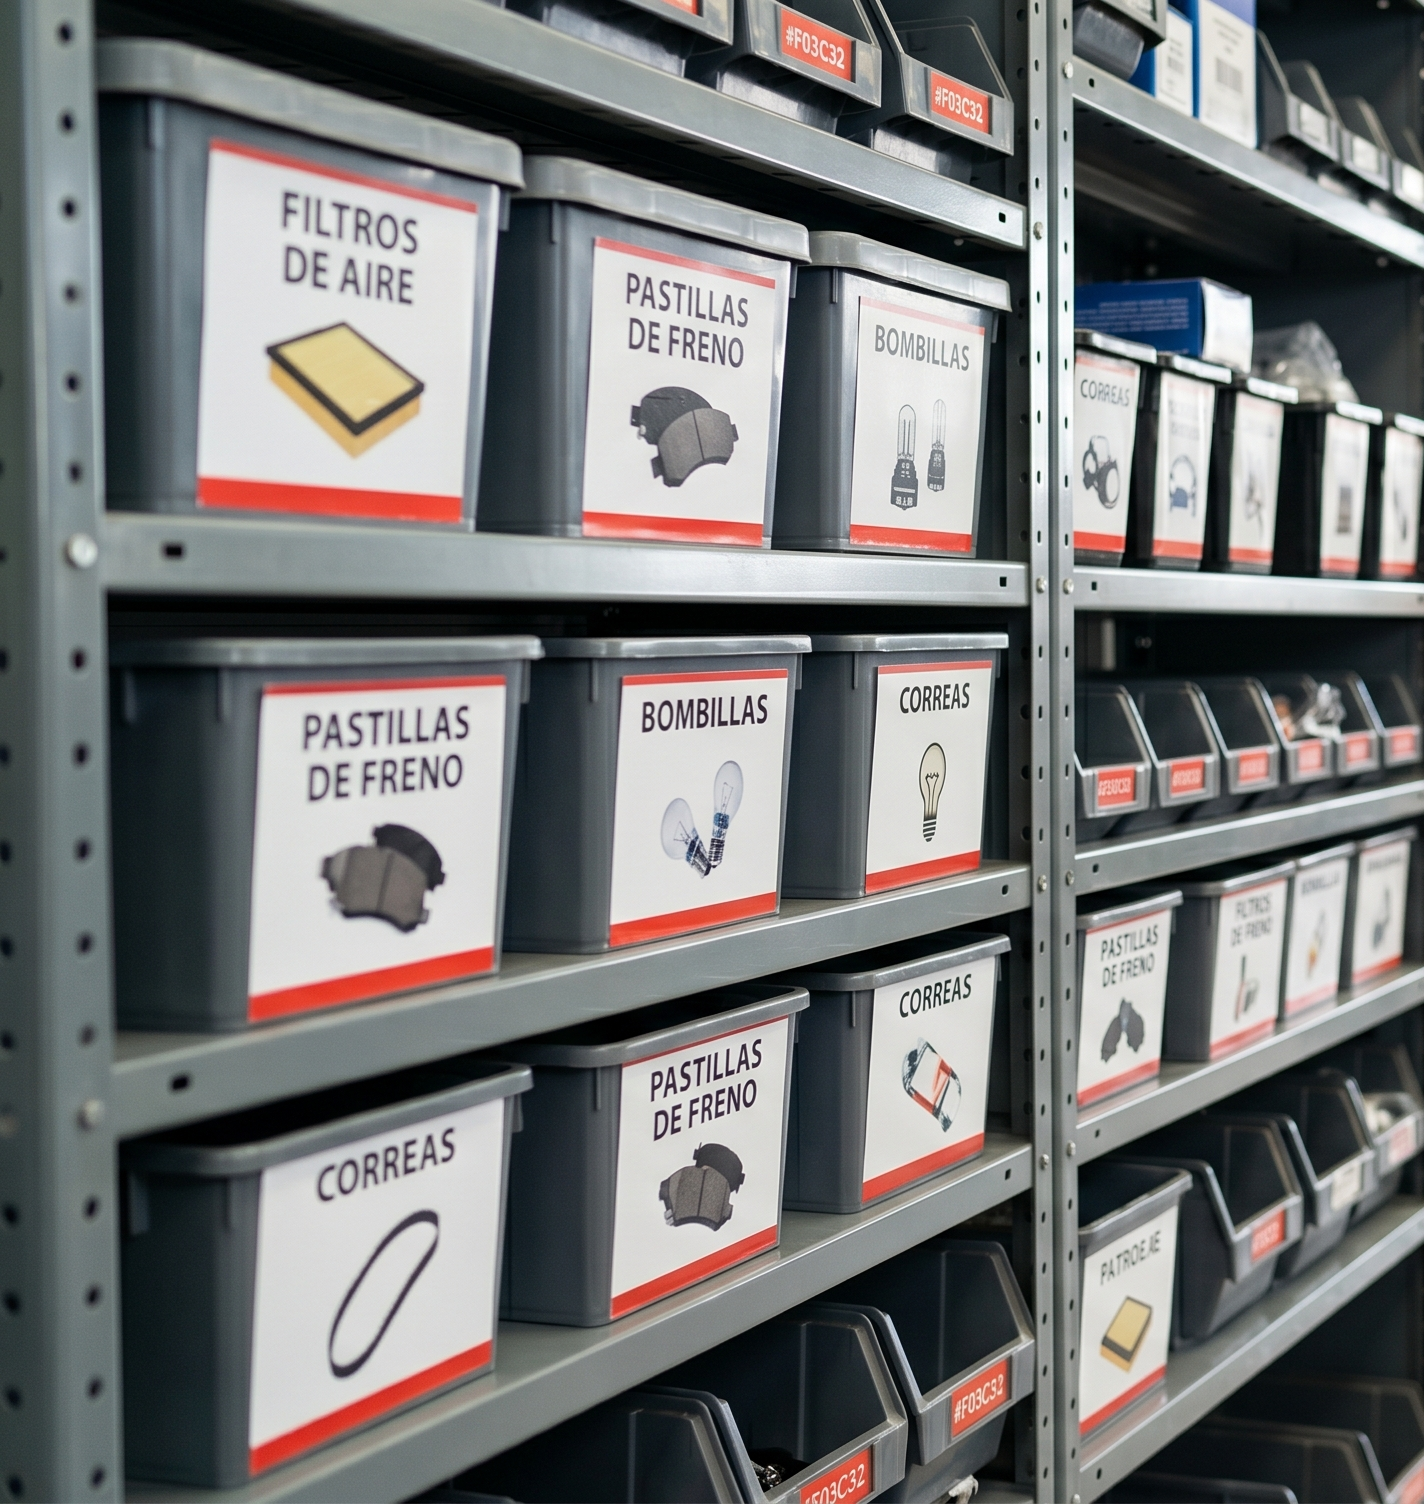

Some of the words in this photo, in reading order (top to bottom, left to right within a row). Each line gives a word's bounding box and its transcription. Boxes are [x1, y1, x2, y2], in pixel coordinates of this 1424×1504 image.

[785, 25, 845, 70] #F03C32
[934, 86, 983, 124] #F03C32
[282, 191, 419, 255] FILTROS
[284, 246, 328, 289] DE
[340, 257, 415, 305] AIRE
[627, 272, 748, 328] PASTILLAS
[629, 318, 660, 354] DE
[669, 326, 745, 368] FRENO
[875, 324, 969, 371] BOMBILLAS
[642, 694, 767, 732] BOMBILLAS
[900, 682, 970, 714] CORREAS
[304, 706, 469, 749] PASTILLAS
[309, 763, 349, 801] DE
[362, 754, 462, 795] FRENO
[1101, 924, 1158, 961] PASTILLAS
[1103, 964, 1117, 988] DE
[1120, 952, 1155, 980] FRENO
[899, 973, 972, 1018] CORREAS
[649, 1038, 763, 1102] PASTILLAS
[653, 1109, 682, 1141] DE
[688, 1079, 757, 1129] FRENO
[316, 1127, 456, 1202] CORREAS
